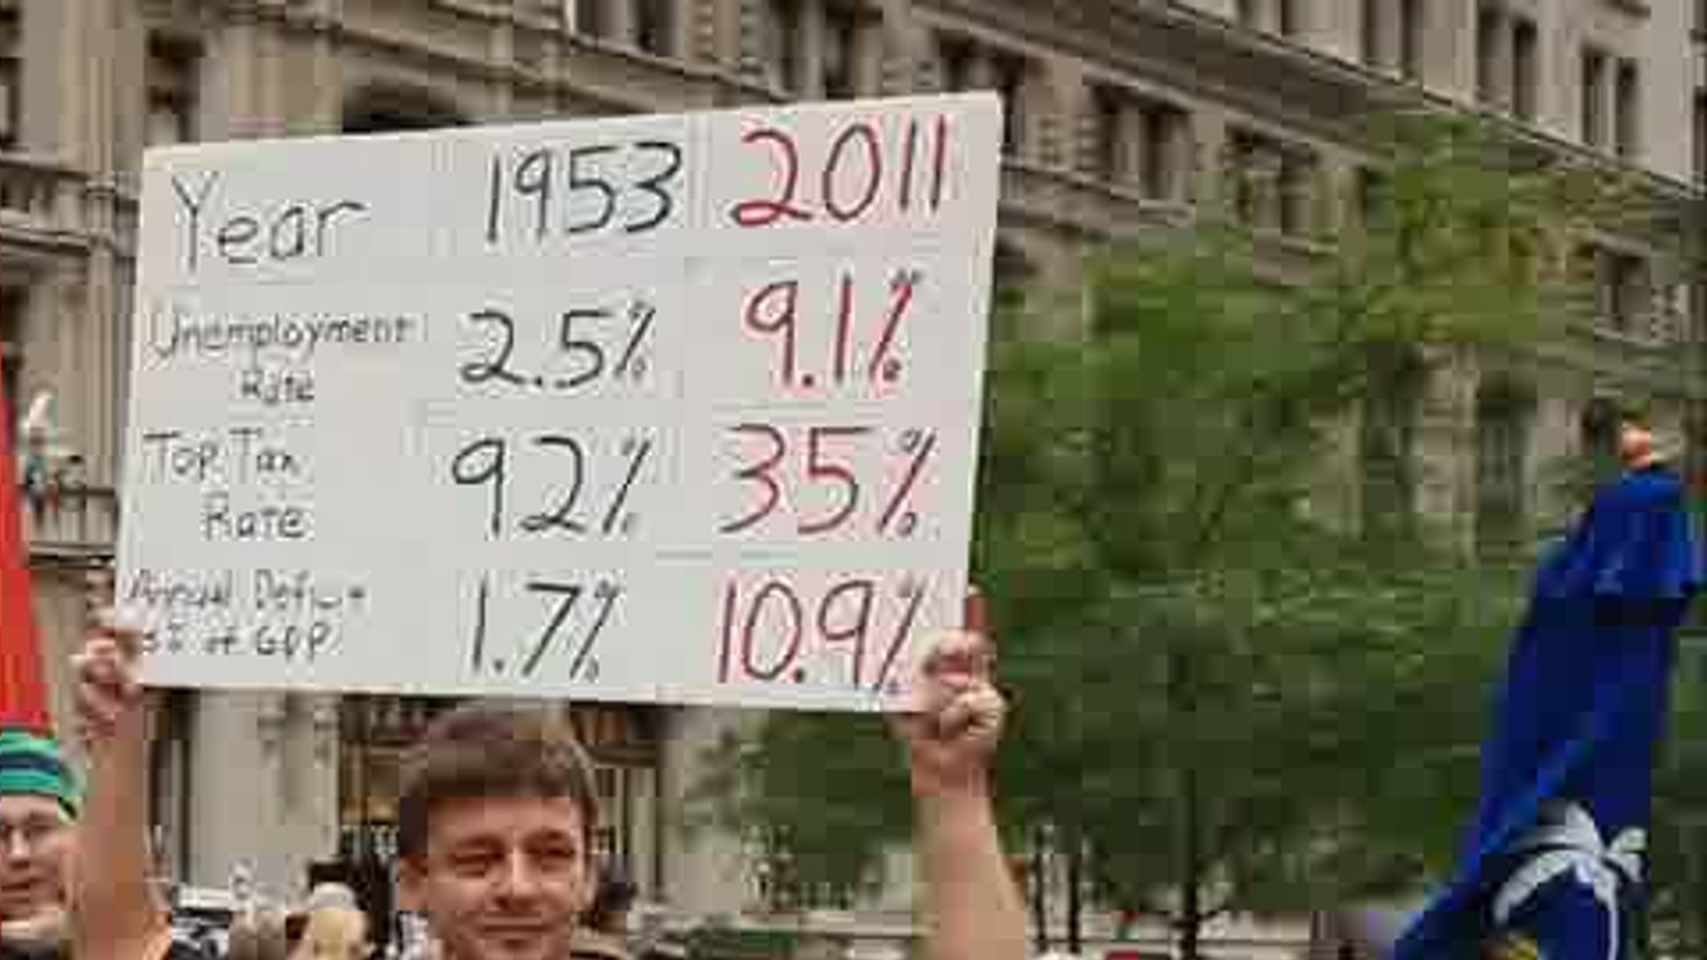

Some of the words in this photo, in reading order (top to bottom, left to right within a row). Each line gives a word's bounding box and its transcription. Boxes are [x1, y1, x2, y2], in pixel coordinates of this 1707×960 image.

[171, 170, 365, 274] Year
[486, 141, 682, 243] 1953
[731, 115, 947, 224] 2011
[147, 312, 414, 364] Unemployment
[459, 301, 657, 387] 2.5%
[745, 270, 920, 388] 9.1%
[240, 368, 315, 404] Rate
[143, 430, 218, 482] Top
[451, 436, 651, 537] 92%
[719, 423, 935, 537] 35%
[202, 490, 306, 540] Rate
[472, 574, 619, 681] 1.7%
[717, 577, 922, 697] 10.9%
